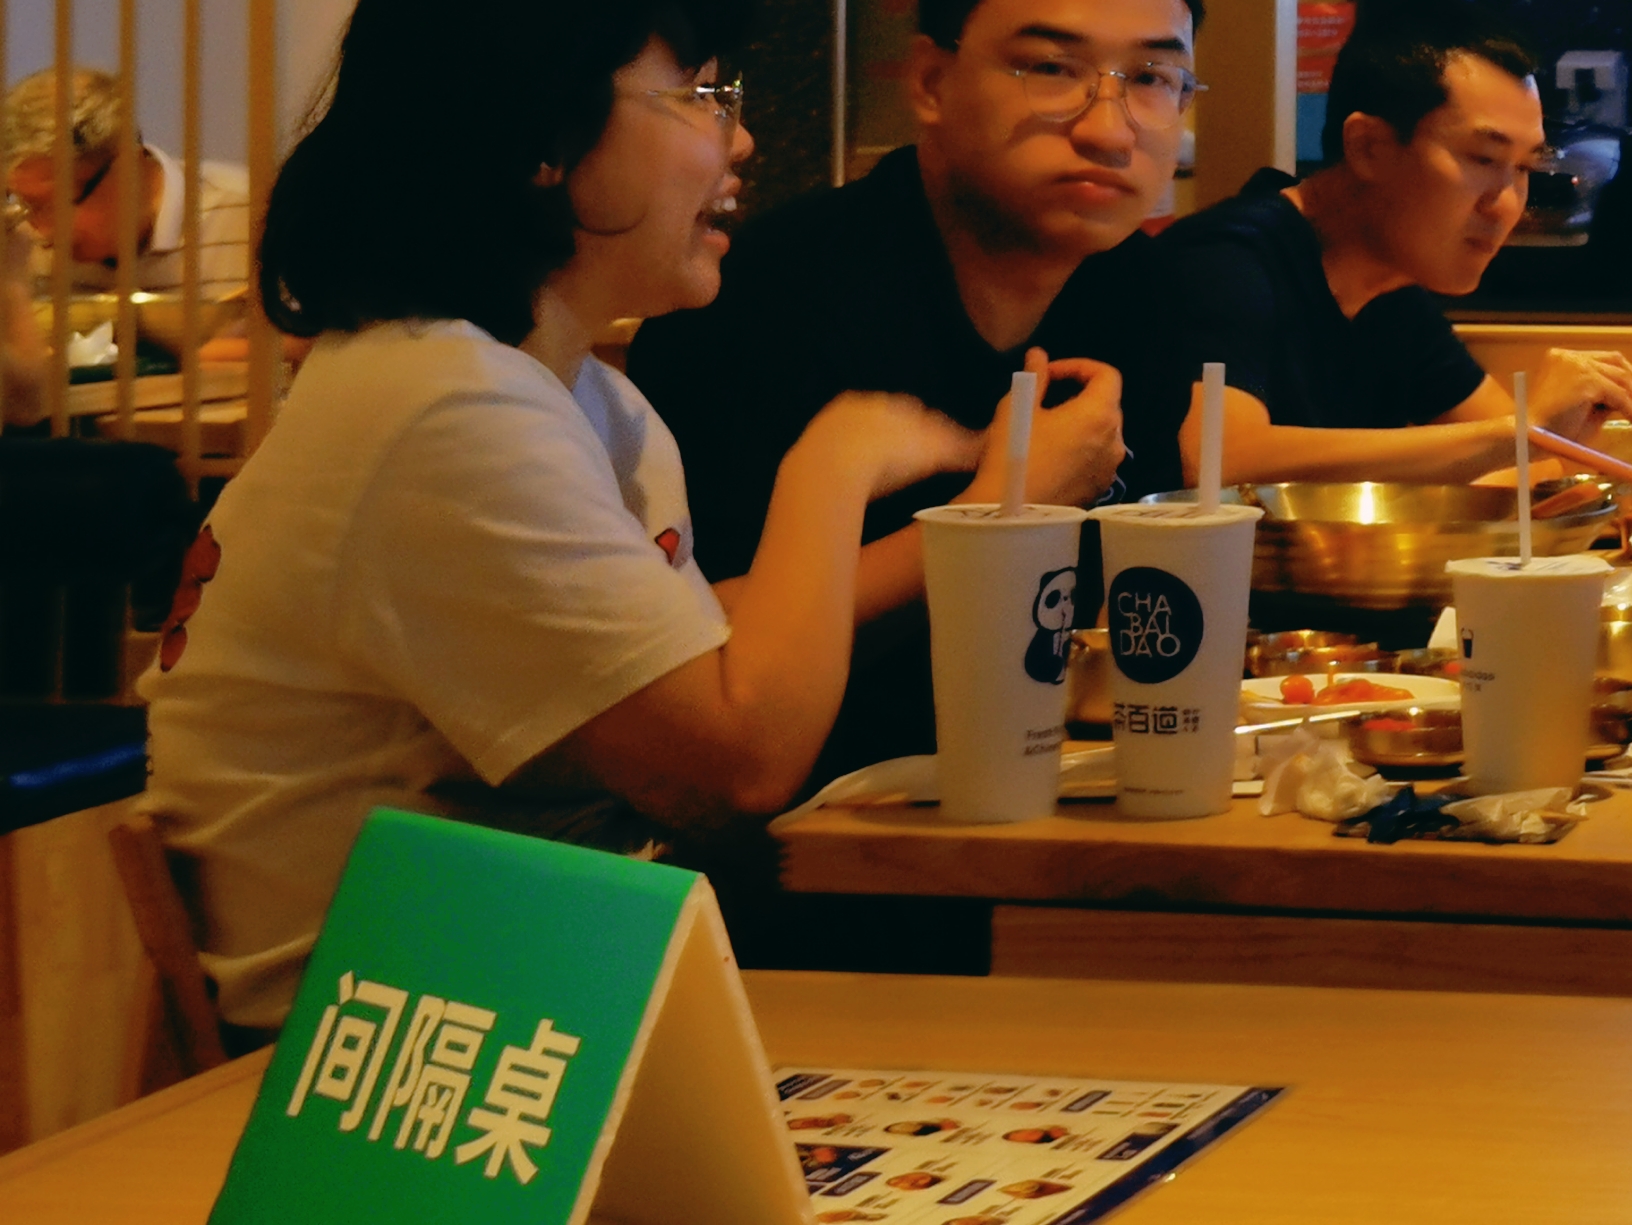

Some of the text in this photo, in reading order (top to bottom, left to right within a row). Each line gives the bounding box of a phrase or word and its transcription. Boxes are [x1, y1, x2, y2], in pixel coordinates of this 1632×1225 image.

[1117, 591, 1172, 616] CHA
[1129, 612, 1170, 637] BAI
[1119, 629, 1181, 658] DAO
[285, 970, 582, 1185] 间隔桌
